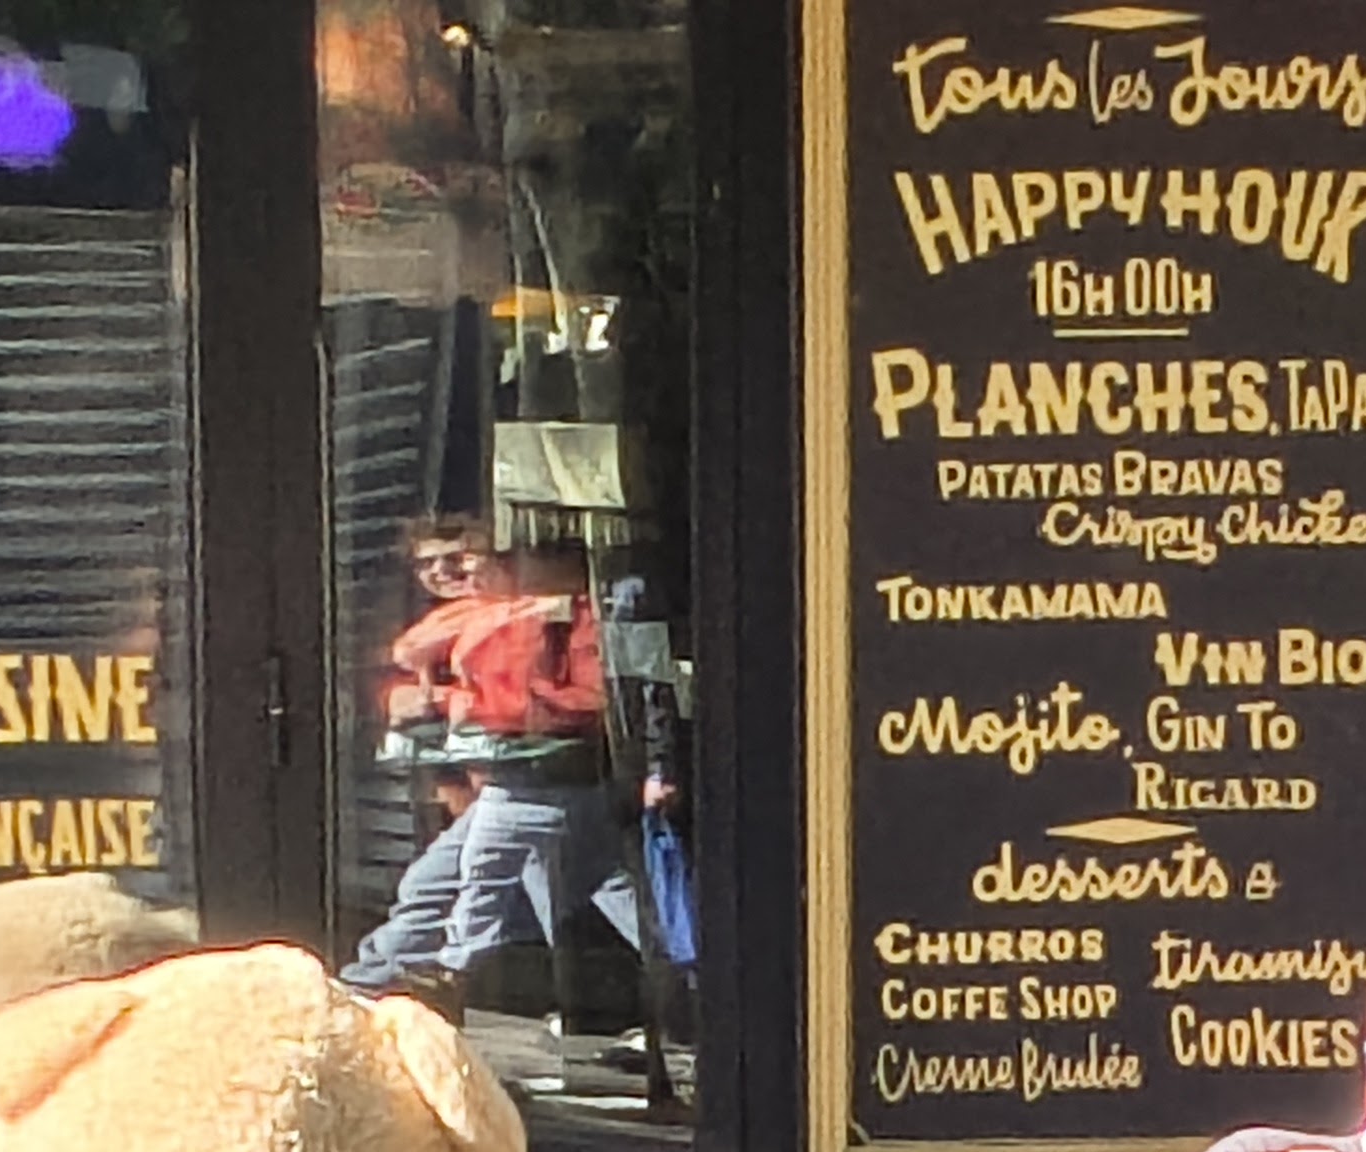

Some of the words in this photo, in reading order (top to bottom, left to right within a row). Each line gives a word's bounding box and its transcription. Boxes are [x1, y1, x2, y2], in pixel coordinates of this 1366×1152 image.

[894, 169, 1153, 275] HAPPY
[937, 459, 1104, 501] PATATAS
[1113, 449, 1284, 497] BRAVAS
[1041, 501, 1217, 563] Crispy
[875, 575, 1168, 622] TONKAMAMA
[1154, 631, 1267, 687] VIN
[1146, 695, 1227, 753] GIN
[1235, 700, 1297, 751] TO
[1131, 761, 1317, 811] RICARD
[972, 841, 1229, 903] desserts
[873, 922, 1104, 965] CHURROS
[881, 978, 1009, 1021] COFFE
[1019, 975, 1117, 1021] SHOP
[1170, 1004, 1360, 1068] COOKIES
